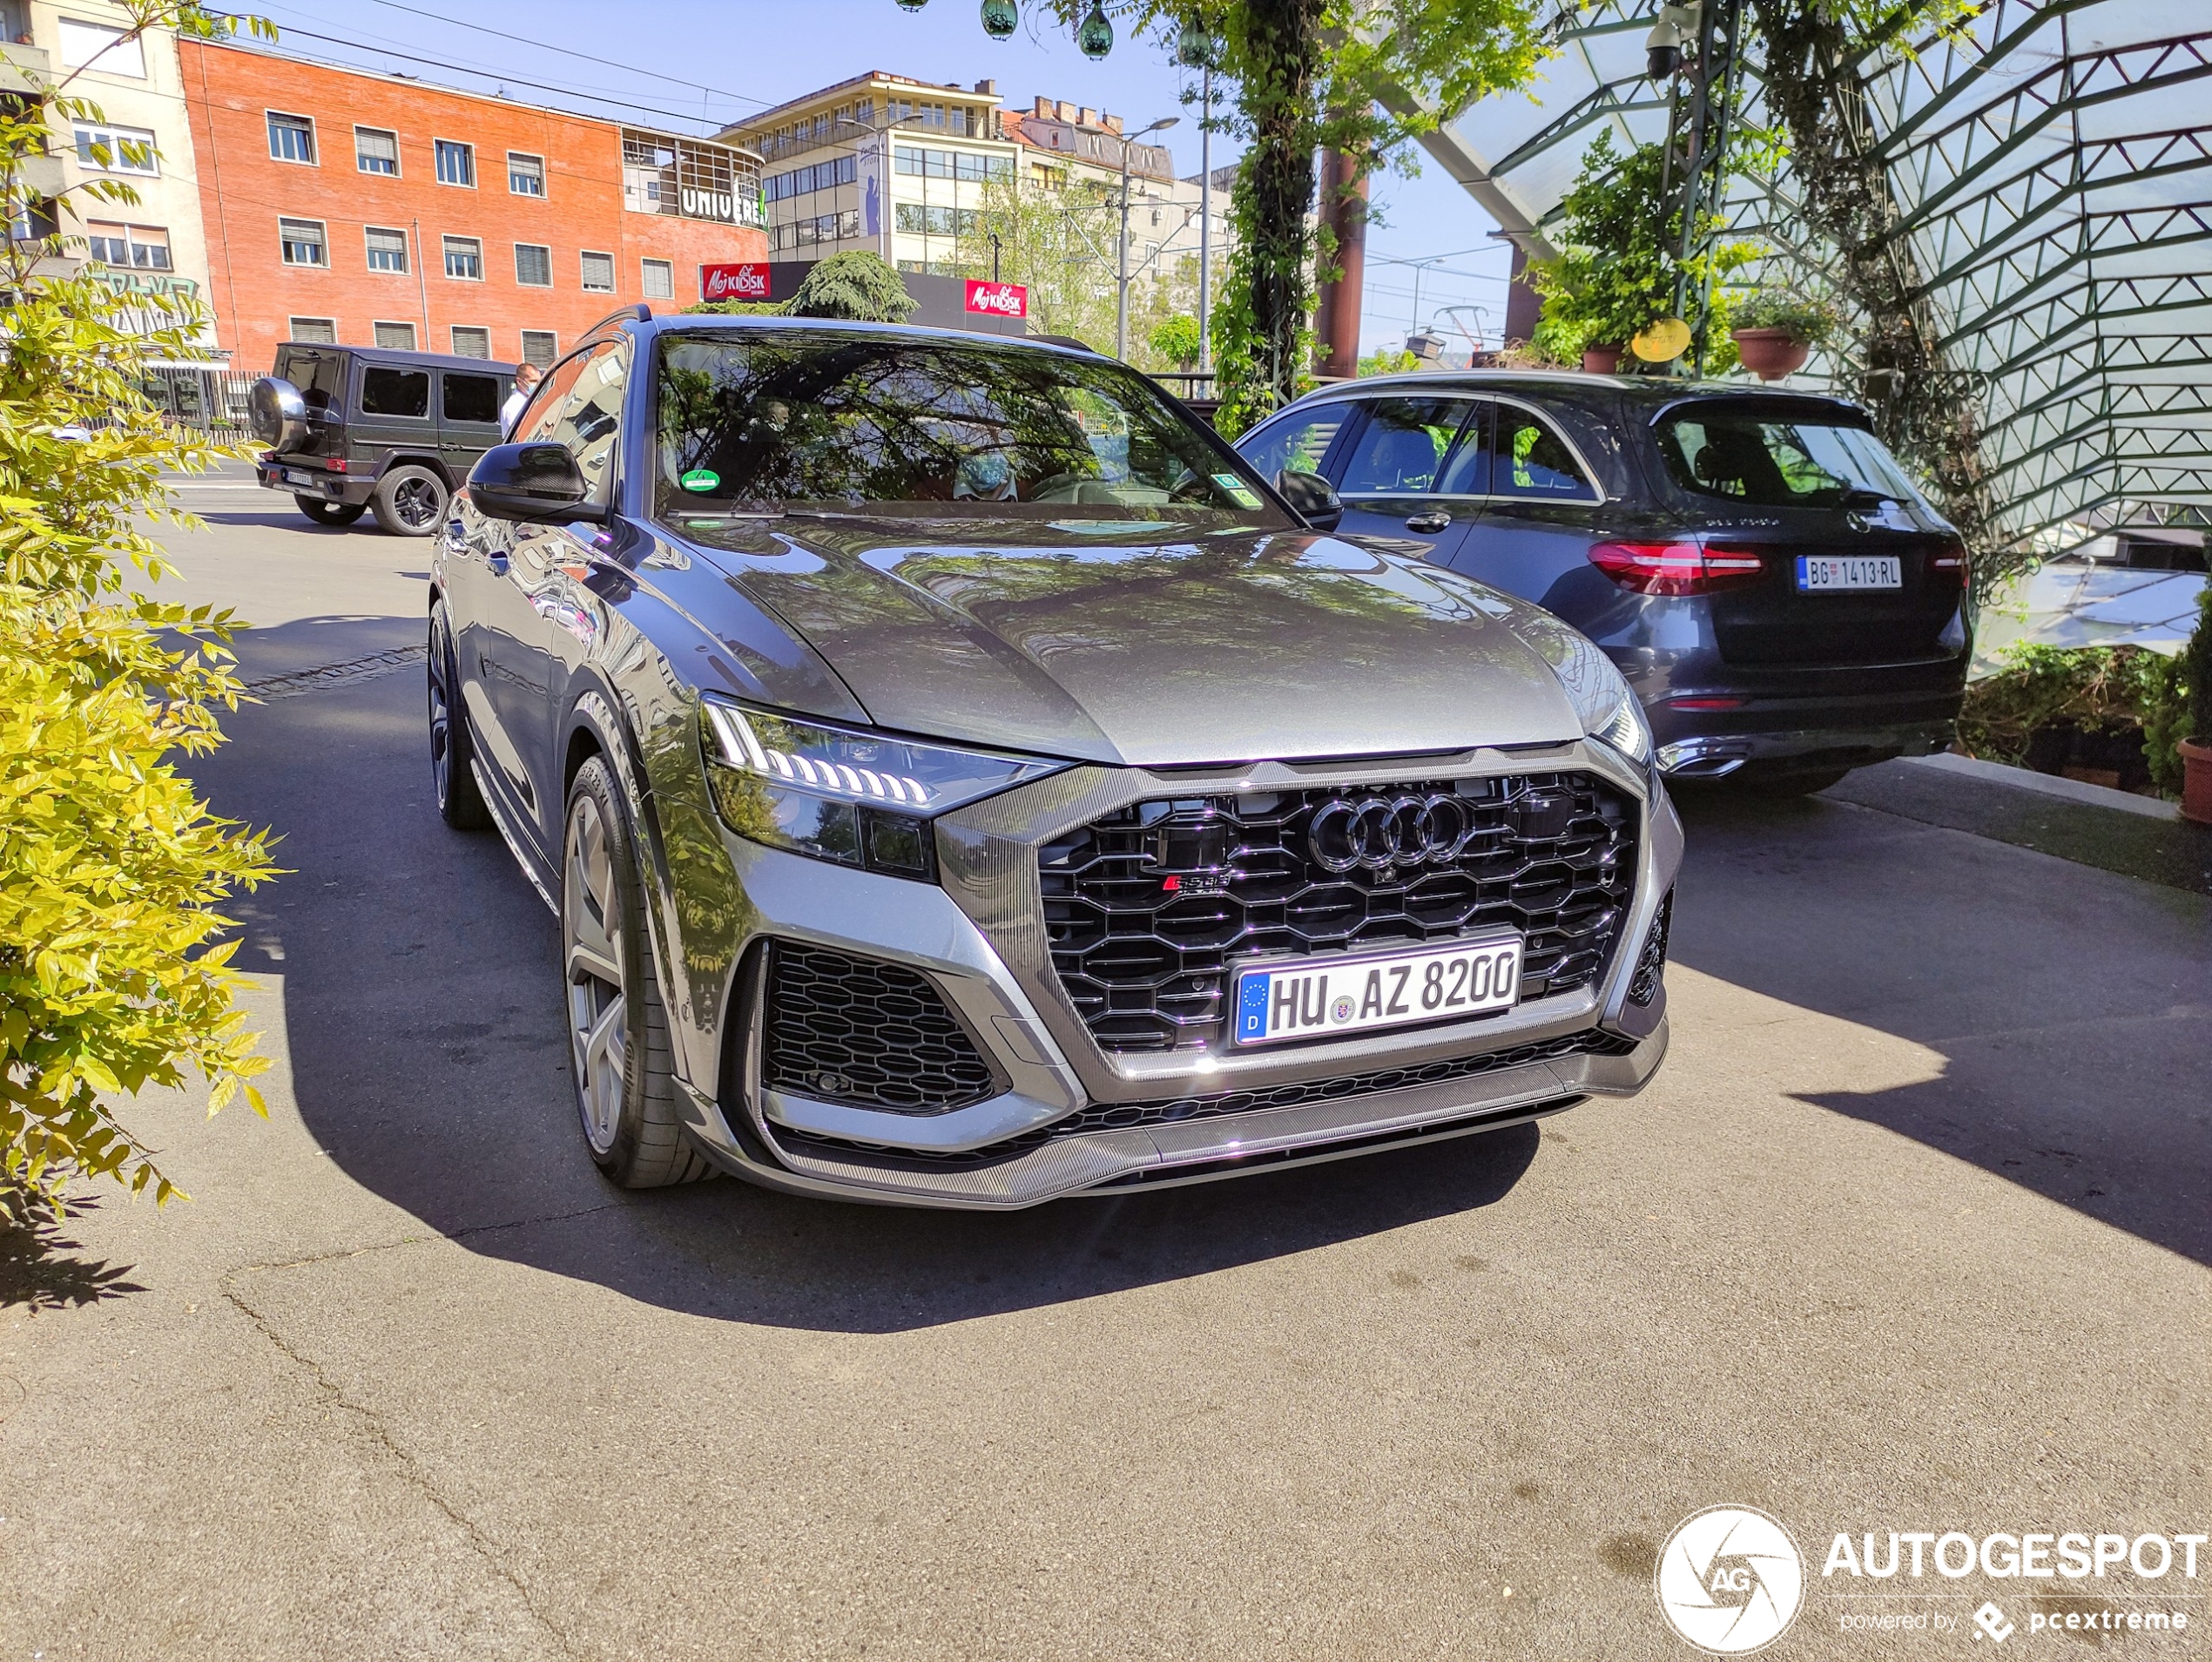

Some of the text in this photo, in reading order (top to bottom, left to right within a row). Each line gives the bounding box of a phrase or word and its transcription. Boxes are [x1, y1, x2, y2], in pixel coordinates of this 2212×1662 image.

[1811, 562, 1829, 584] BG
[1271, 975, 1328, 1030] HU
[1359, 965, 1411, 1019] AZ
[1421, 951, 1514, 1010] 8200
[1248, 1015, 1258, 1030] D
